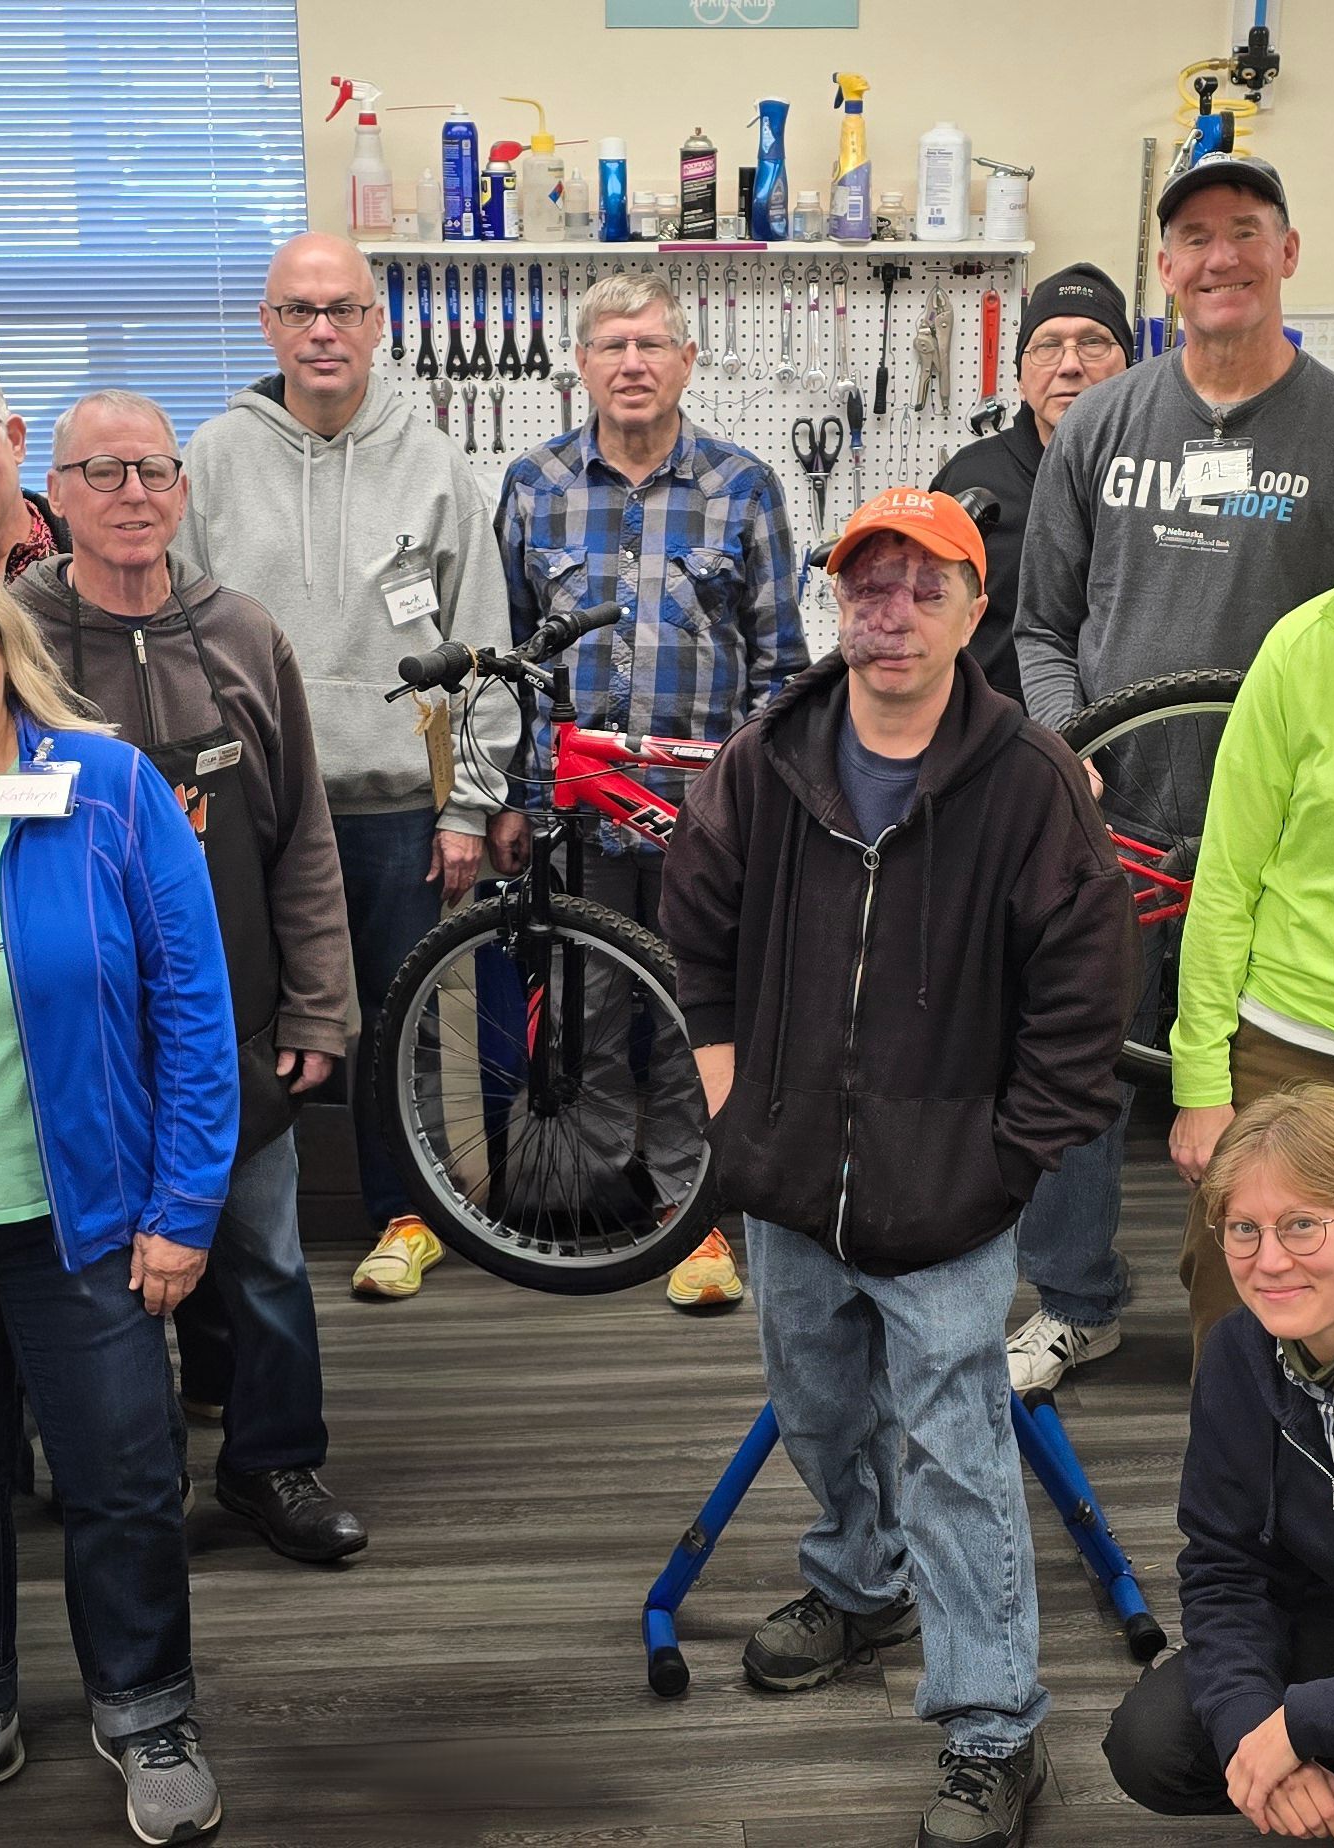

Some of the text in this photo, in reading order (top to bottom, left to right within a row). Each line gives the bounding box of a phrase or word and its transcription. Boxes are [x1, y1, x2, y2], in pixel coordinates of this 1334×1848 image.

[1102, 456, 1220, 516] GIV
[892, 493, 935, 511] LBK
[0, 785, 59, 806] Kathryn
